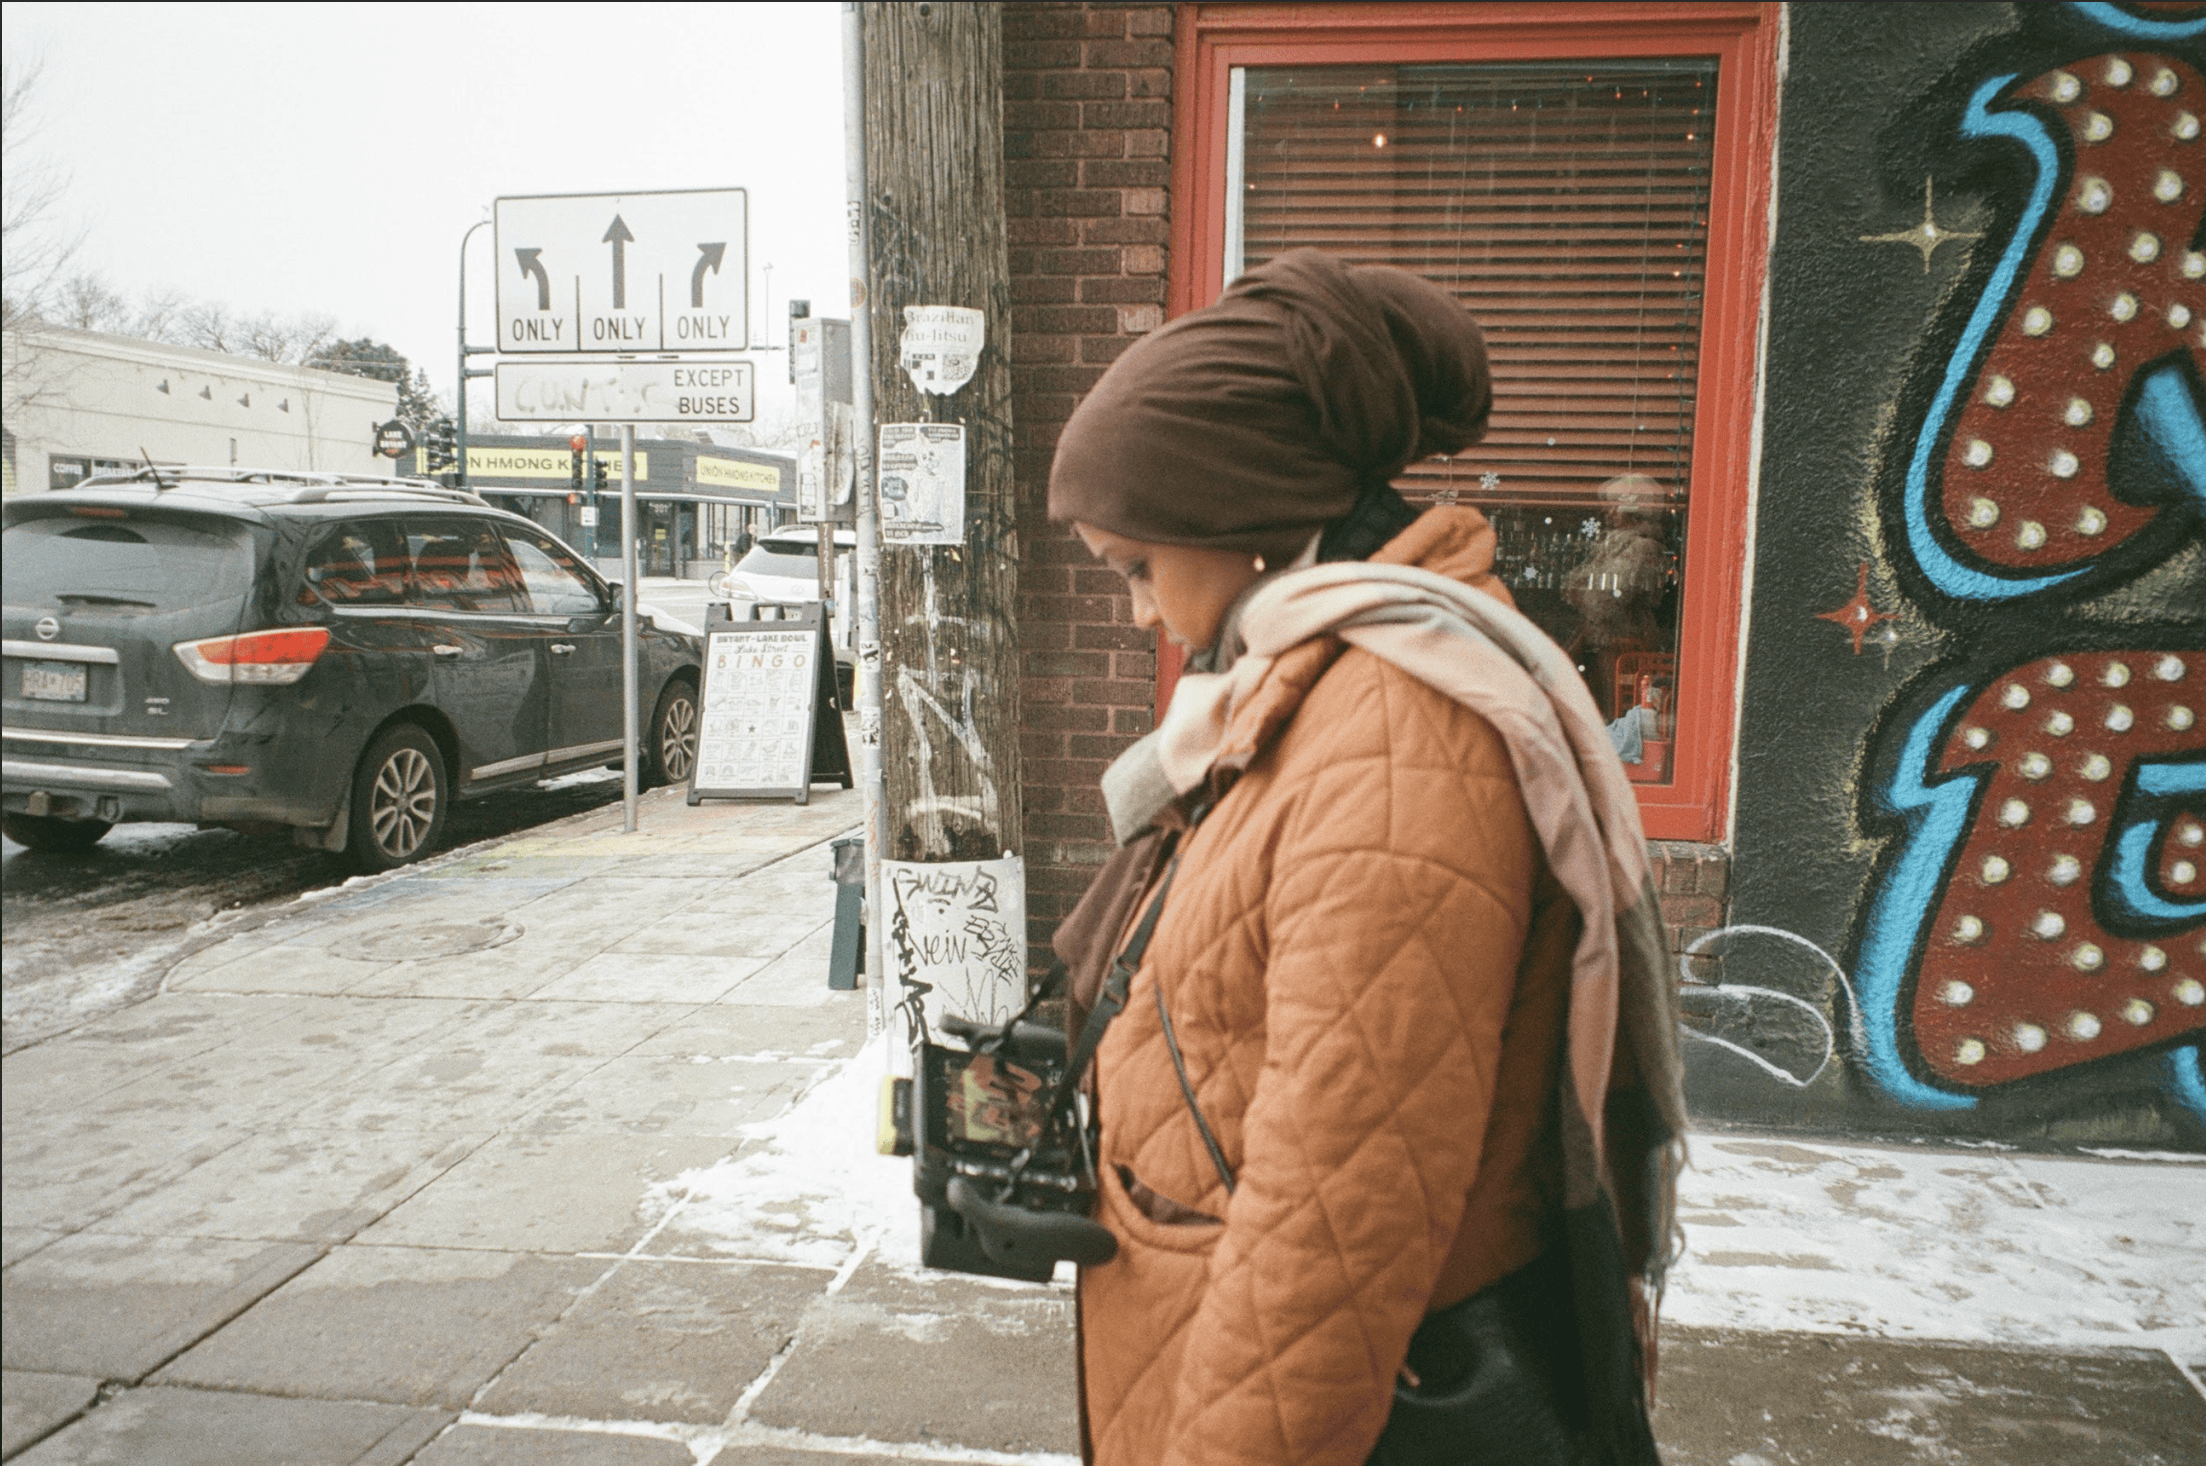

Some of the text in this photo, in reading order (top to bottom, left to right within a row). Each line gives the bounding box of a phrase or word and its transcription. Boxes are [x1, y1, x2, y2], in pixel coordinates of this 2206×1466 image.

[512, 315, 730, 341] ONLY ONLY ONLY
[674, 368, 745, 387] EXCEPT
[678, 397, 740, 415] BUSES
[487, 453, 552, 470] HMONG
[781, 634, 807, 642] BOWL
